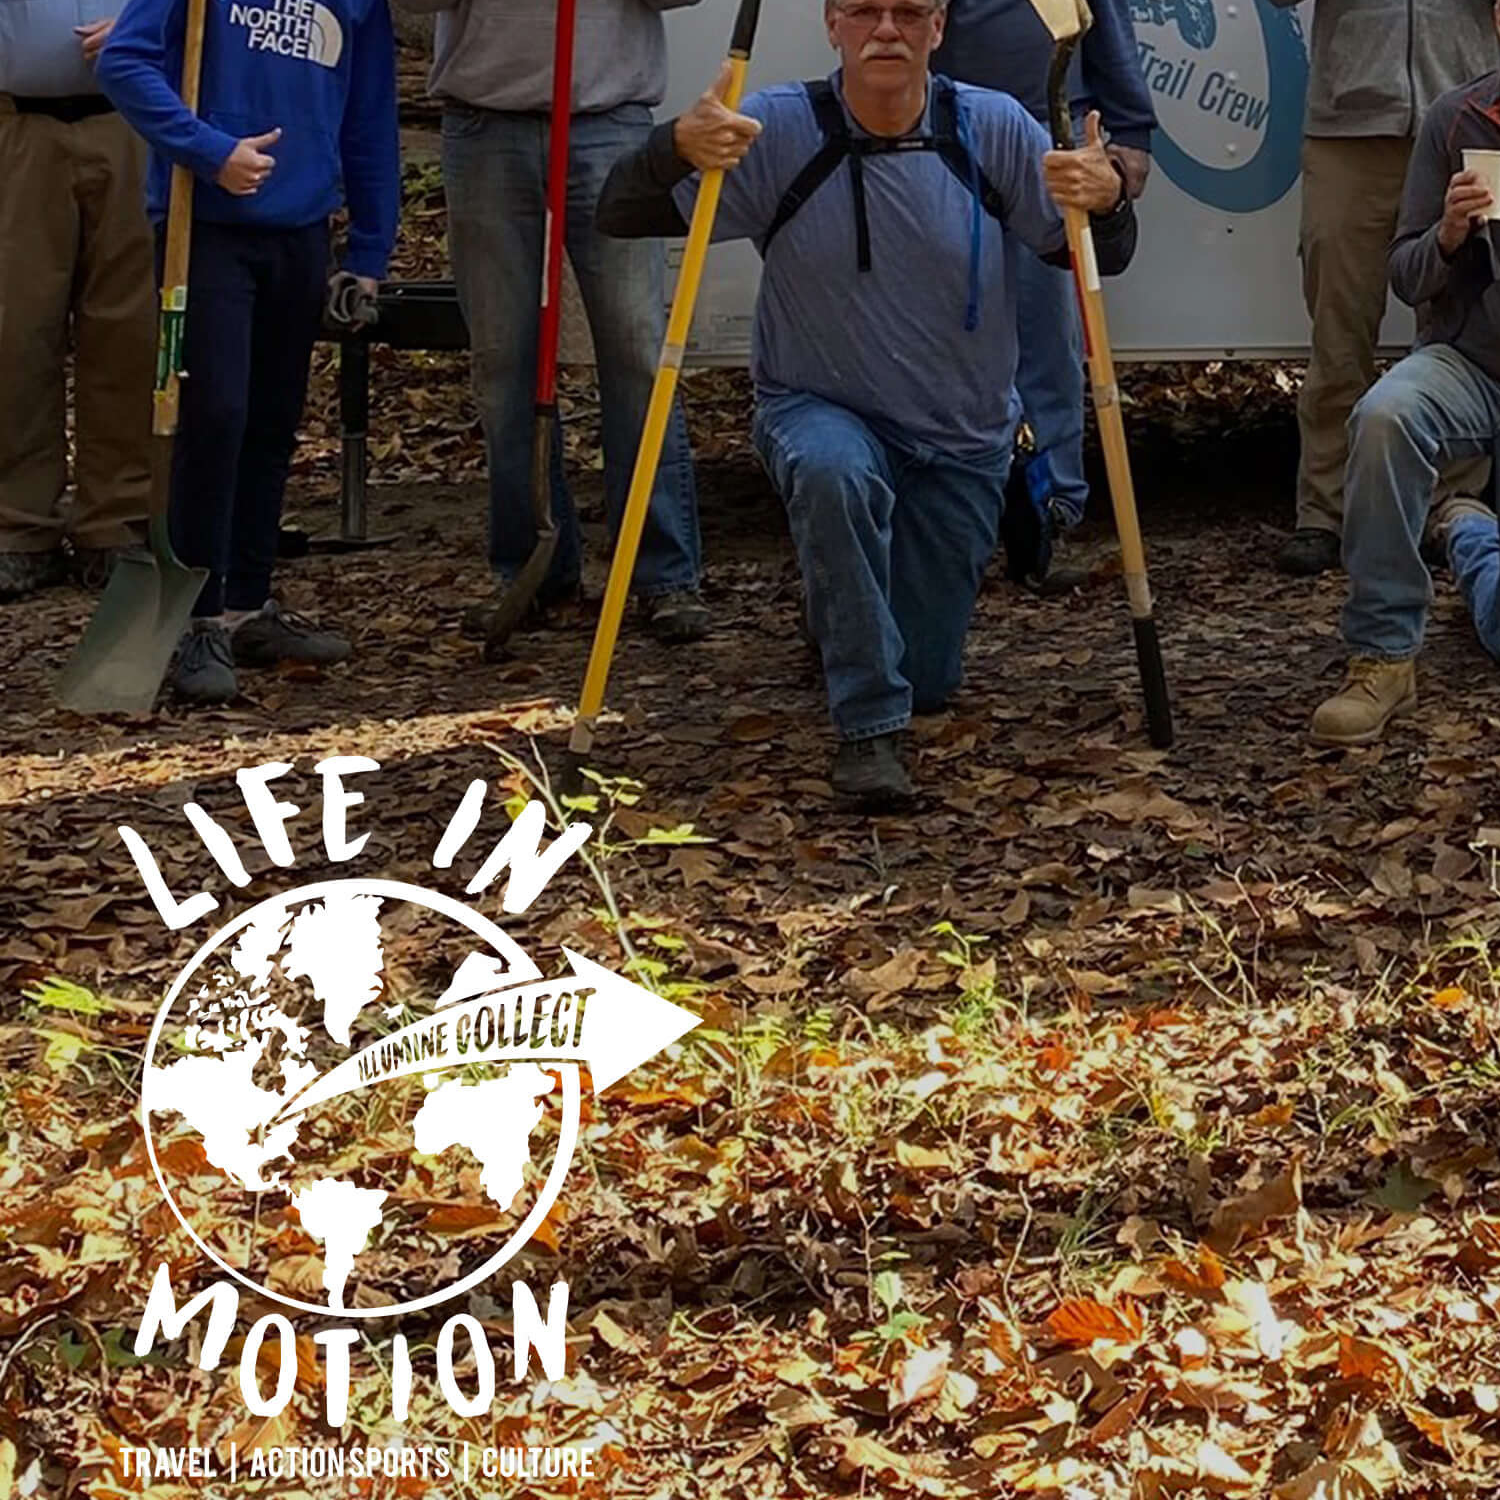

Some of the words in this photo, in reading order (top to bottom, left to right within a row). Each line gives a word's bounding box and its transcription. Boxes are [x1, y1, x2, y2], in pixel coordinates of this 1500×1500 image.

[229, 3, 311, 39] NORTH
[247, 28, 309, 59] FACE
[1197, 71, 1272, 131] Crew
